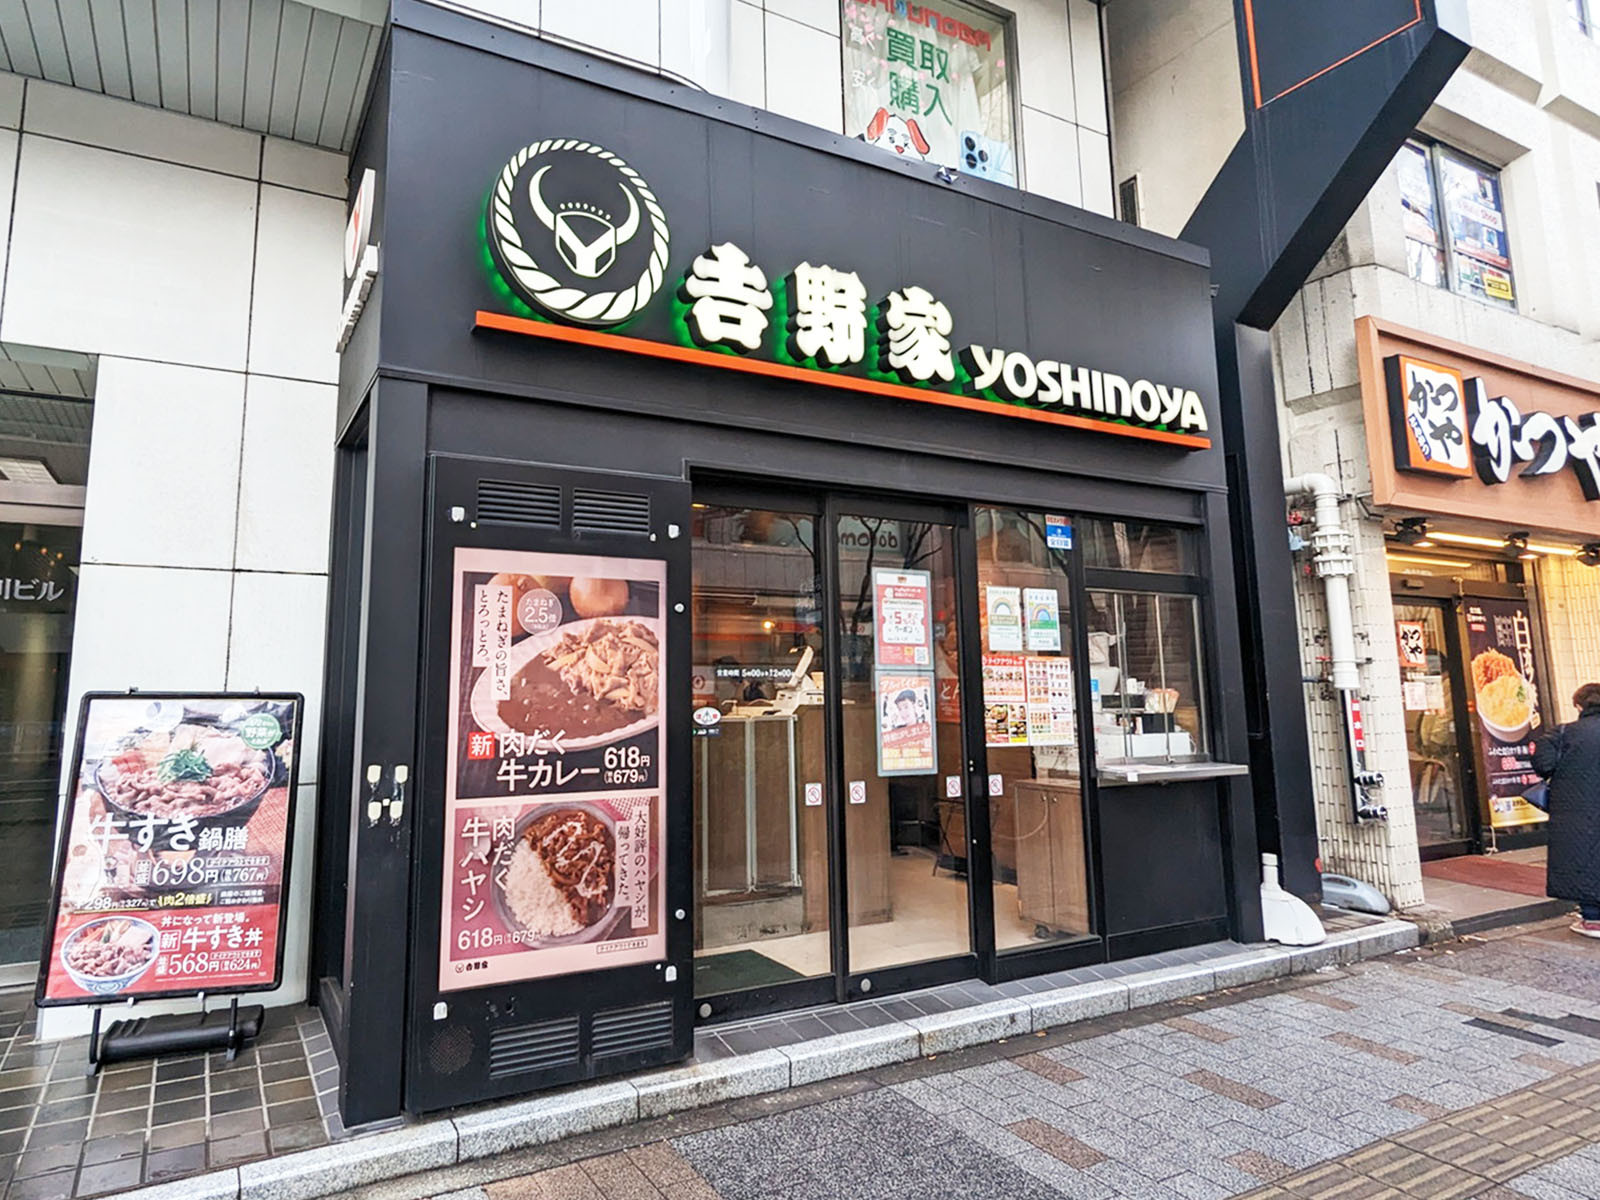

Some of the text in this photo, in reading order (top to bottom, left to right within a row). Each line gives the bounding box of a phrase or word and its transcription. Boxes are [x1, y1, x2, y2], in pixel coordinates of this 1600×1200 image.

[887, 27, 949, 84] 買取
[889, 71, 952, 126] 購入
[967, 344, 1208, 431] YOSHINOYA
[1408, 371, 1464, 460] かつや
[477, 590, 490, 662] とろっとろ。
[471, 729, 567, 758] 新 肉だく
[604, 746, 650, 769] 618円
[496, 758, 600, 791] 牛カレー
[88, 811, 249, 854] 牛すき鍋膳
[492, 816, 515, 891] 肉だく
[152, 857, 218, 886] 698円
[460, 817, 490, 921] 牛ハヤシ
[161, 925, 264, 951] 新 牛すき丼
[457, 927, 503, 951] 618円
[168, 951, 219, 975] 568円
